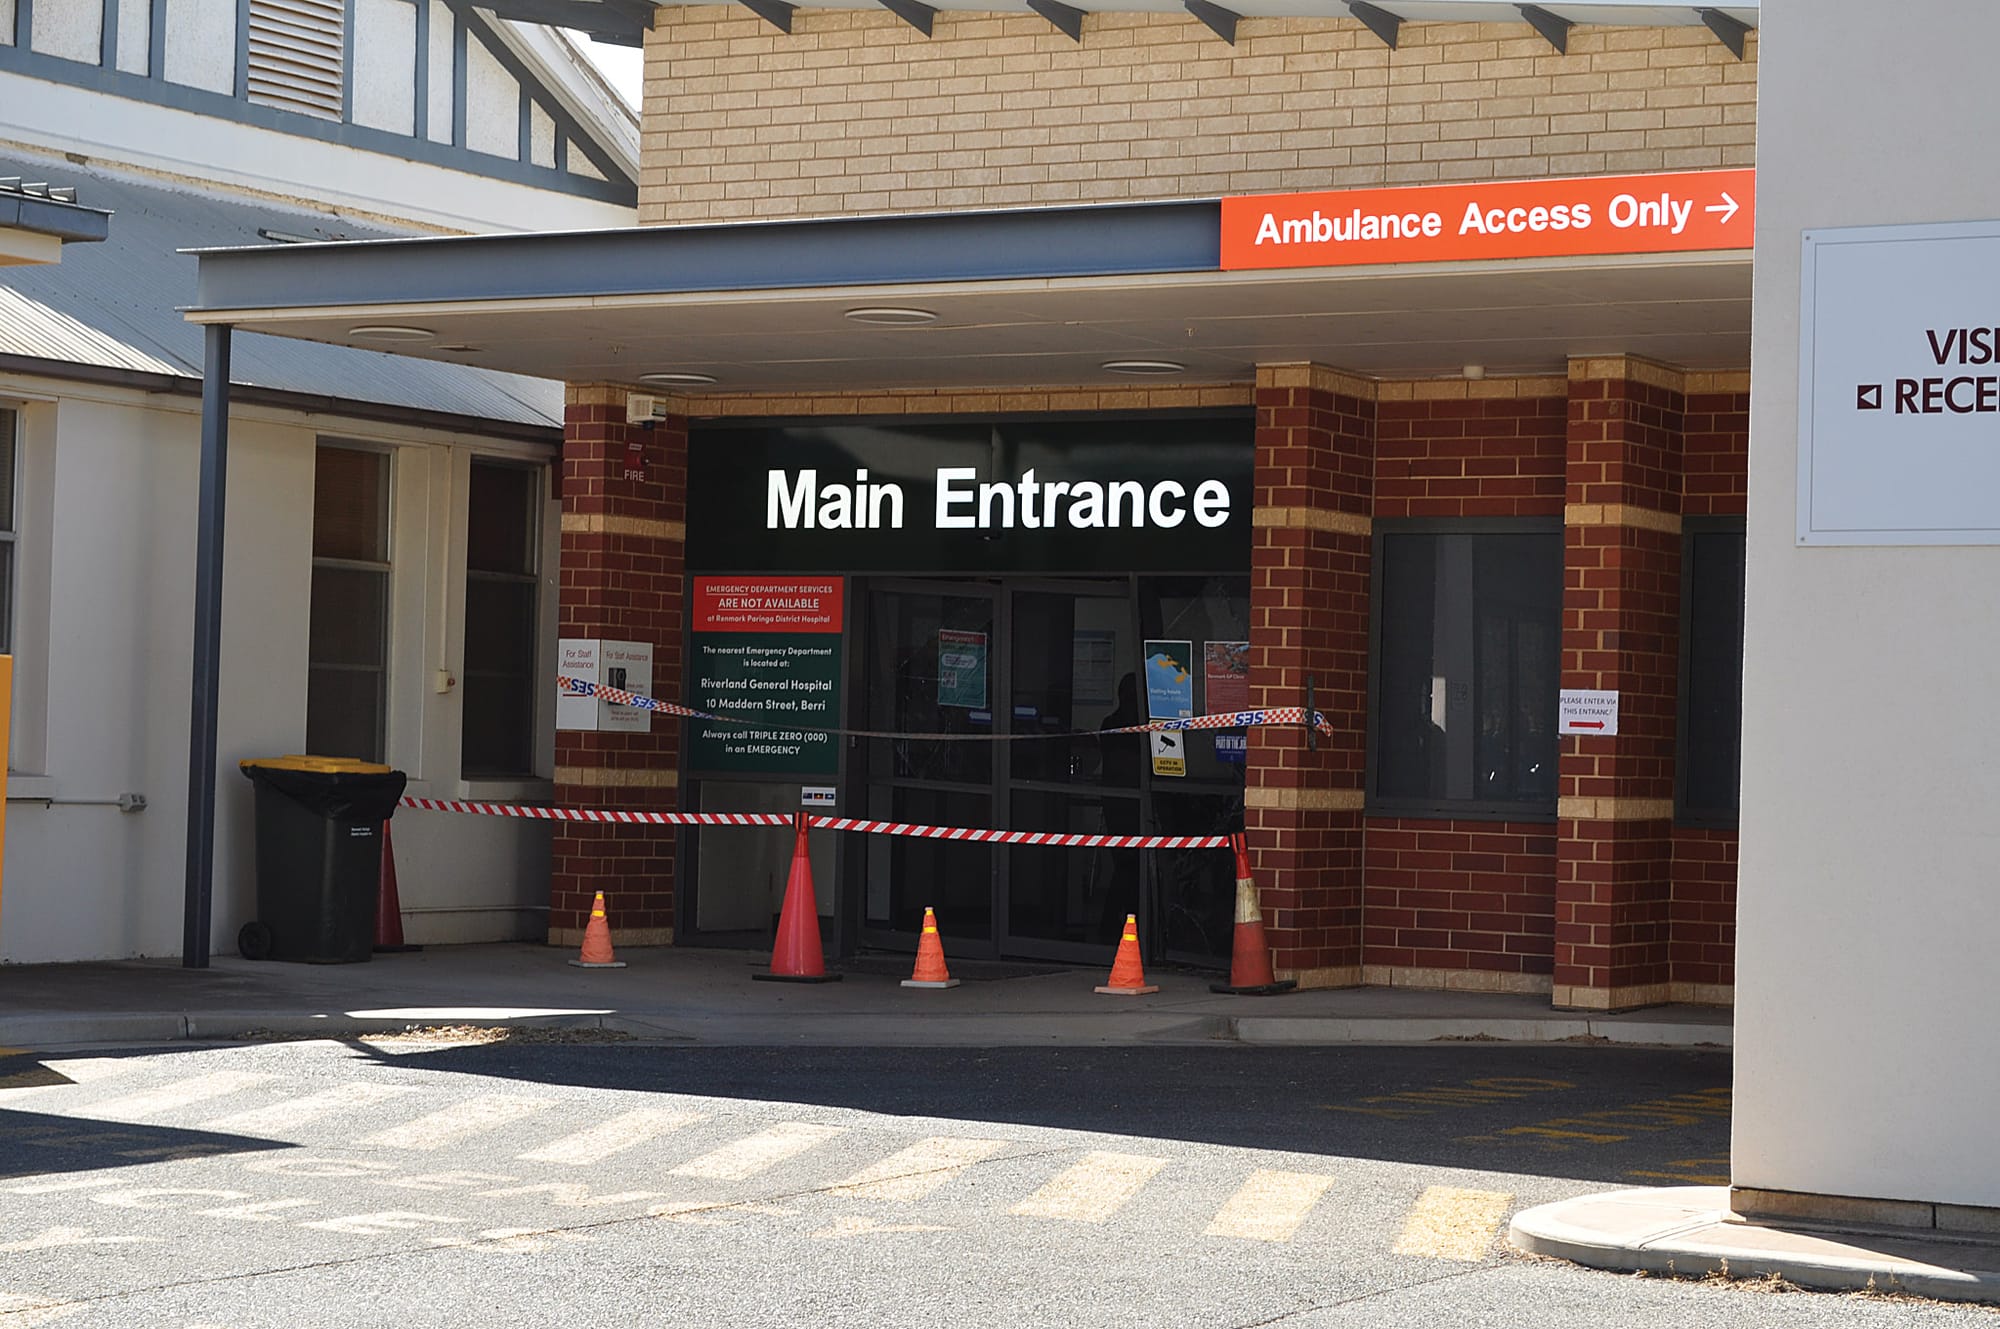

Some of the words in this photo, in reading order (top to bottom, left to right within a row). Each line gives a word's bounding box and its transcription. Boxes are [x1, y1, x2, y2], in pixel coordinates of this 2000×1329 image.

[1255, 209, 1441, 245] Ambulance
[1459, 201, 1591, 236] Access
[1608, 191, 1693, 234] Only
[1894, 376, 2000, 414] RECE
[624, 469, 645, 482] FIRE
[766, 468, 903, 530] Main
[935, 467, 1231, 530] Entrance
[706, 585, 749, 593] EMERGENCY
[750, 585, 797, 593] DEPARTMENT
[718, 597, 738, 608] ARE
[740, 598, 762, 608] NOT
[764, 598, 819, 609] AVAILABLE
[716, 614, 746, 622] Renmark
[747, 615, 774, 625] Paringa
[775, 615, 800, 623] District
[801, 615, 830, 625] Hospital
[566, 650, 576, 658] For
[703, 646, 716, 655] The
[717, 647, 745, 655] nearest
[746, 646, 787, 657] Emergency
[787, 647, 832, 657] Department
[743, 659, 749, 667] is
[750, 659, 778, 667] located
[571, 679, 595, 695] SES
[701, 677, 747, 689] Riverland
[749, 679, 788, 690] General
[790, 680, 832, 693] Hospital
[631, 696, 657, 709] SES
[705, 698, 716, 708] 10
[718, 698, 763, 710] Maddern
[765, 699, 799, 712] Street,
[800, 700, 826, 711] Berri
[1560, 697, 1582, 705] PLEASE
[1584, 697, 1605, 705] ENTER
[1606, 697, 1617, 705] VIA
[1563, 707, 1578, 715] THIS
[1579, 708, 1613, 716] ENTRANC
[1235, 712, 1263, 725] SES
[702, 730, 731, 741] Always
[732, 730, 748, 739] call
[749, 731, 777, 740] TRIPLE
[779, 732, 802, 741] ZERO
[804, 732, 828, 744] (000)
[725, 744, 733, 753] in
[747, 745, 801, 755] EMERGENCY
